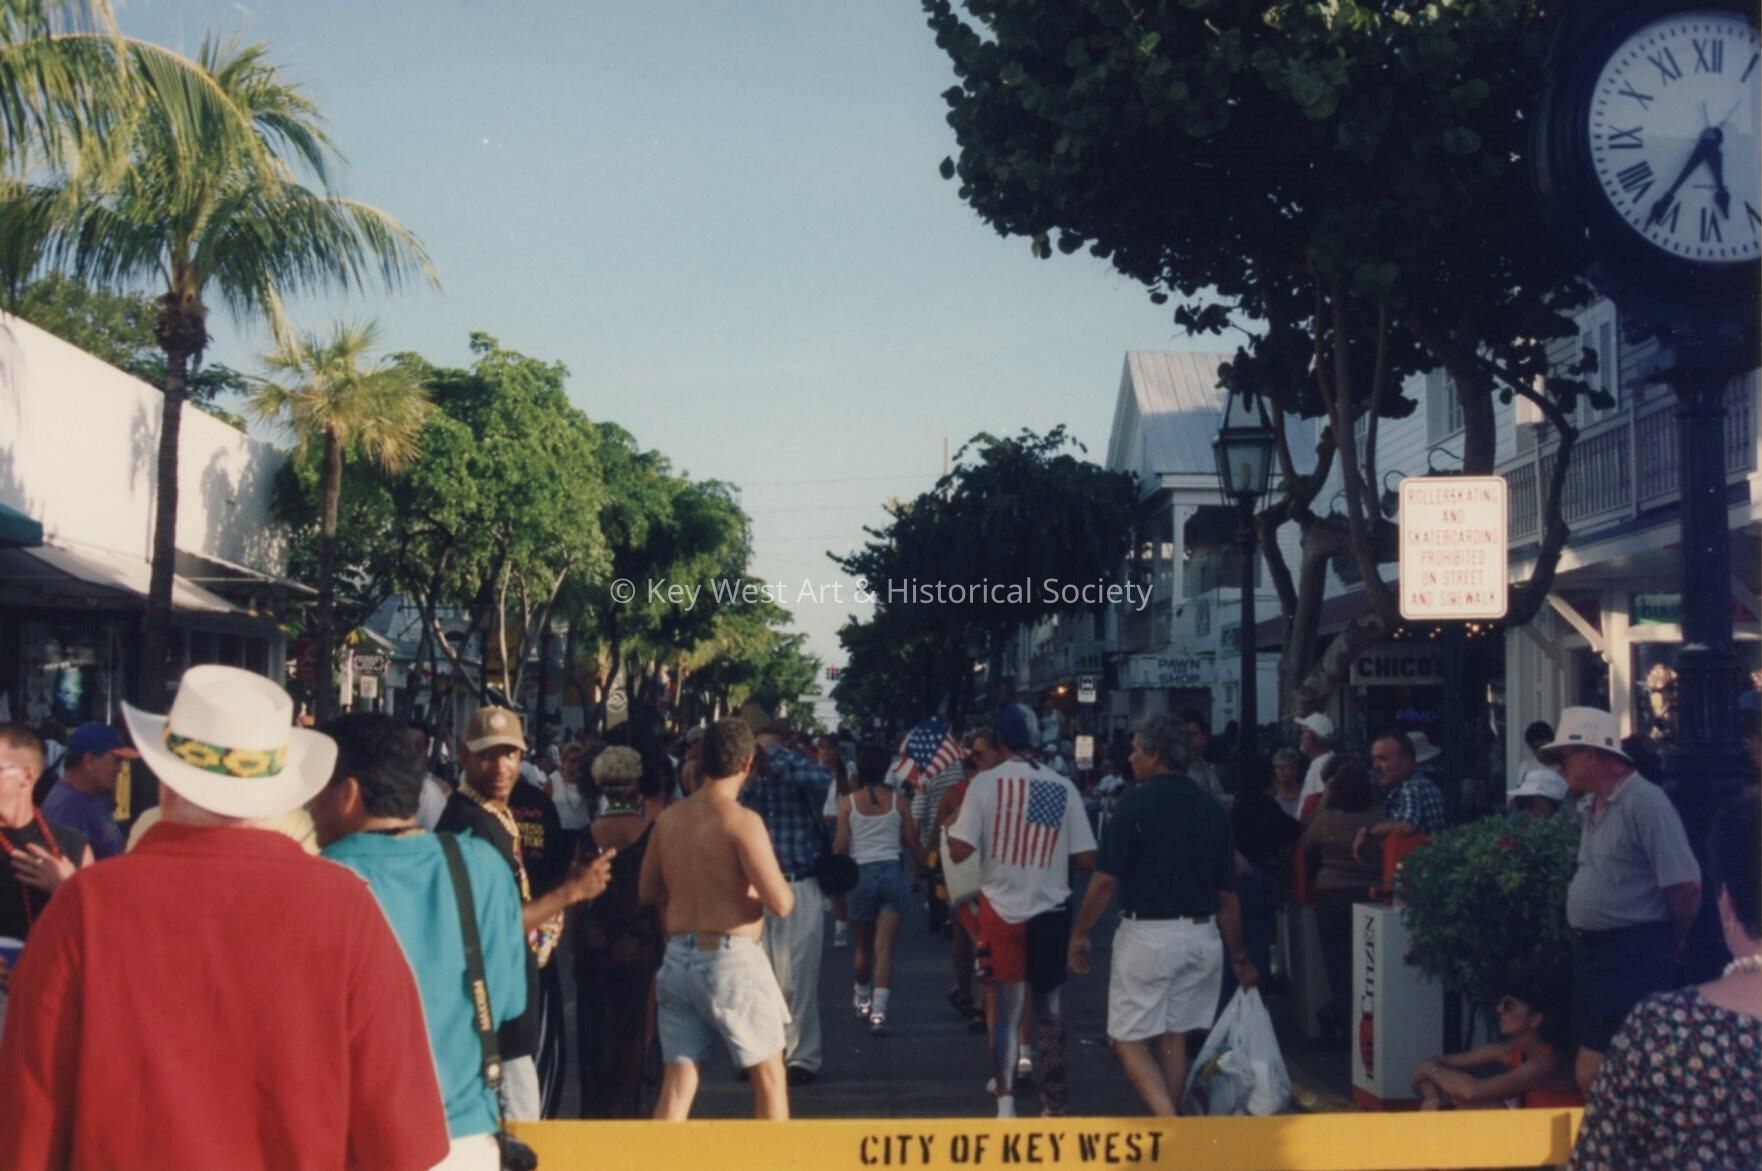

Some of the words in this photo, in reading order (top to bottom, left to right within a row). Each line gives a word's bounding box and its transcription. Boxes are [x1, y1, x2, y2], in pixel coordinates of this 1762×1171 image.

[1692, 39, 1724, 74] XII
[1647, 46, 1682, 87] XI
[1618, 81, 1654, 111] X
[1608, 125, 1643, 149] IX
[1616, 161, 1655, 204] VIII
[1700, 207, 1723, 242] VI
[1408, 488, 1498, 505] ROLLERSKATING
[1442, 509, 1465, 524] AND
[1407, 529, 1499, 546] SKATEBOARDING
[1420, 550, 1486, 566] PROHIBITED
[1423, 570, 1437, 586] ON
[1443, 570, 1484, 586] STREET
[1411, 592, 1433, 608] AND
[1440, 591, 1497, 607] SIDEWALK
[1158, 658, 1201, 671] PAWN
[1158, 673, 1201, 686] SHOP
[860, 1134, 935, 1166] CITY
[950, 1133, 991, 1165] OF
[1002, 1132, 1065, 1164] KEY
[1077, 1131, 1164, 1163] WEST
